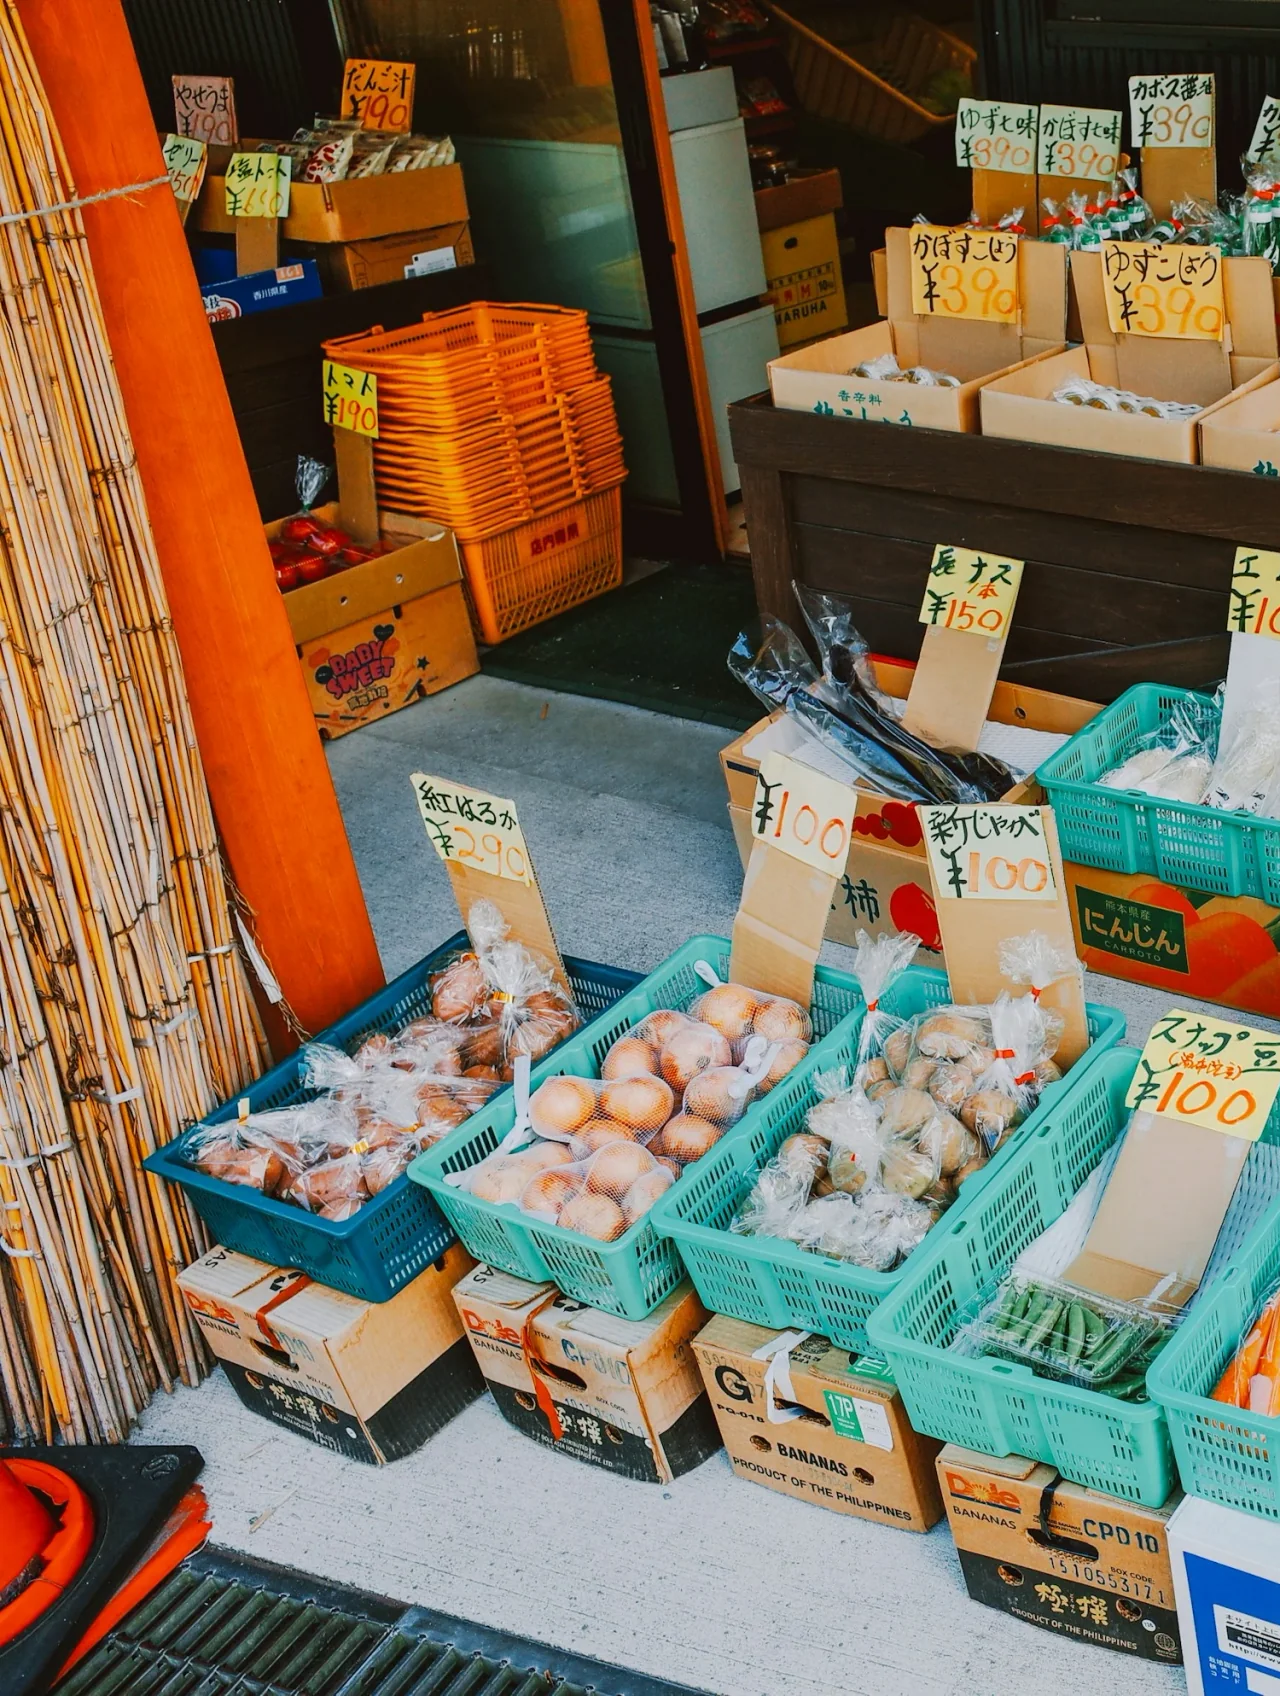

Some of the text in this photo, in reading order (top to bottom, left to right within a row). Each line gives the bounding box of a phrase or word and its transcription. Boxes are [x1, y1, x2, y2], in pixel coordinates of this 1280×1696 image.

[346, 63, 411, 99] だんご汁
[178, 110, 232, 145] ¥190
[349, 94, 408, 128] ¥190
[960, 107, 1037, 138] ゆず七味
[1138, 104, 1211, 143] ¥390
[960, 135, 1030, 168] ¥390
[1045, 139, 1117, 176] ¥390
[922, 262, 1018, 315] ¥390
[1114, 281, 1222, 334] ¥390
[327, 363, 373, 397] トマト
[837, 388, 882, 406] 香辛料
[324, 391, 377, 432] ¥190
[930, 546, 1013, 586] 長ナス
[927, 588, 1003, 632] ¥150
[328, 639, 384, 676] BABY
[326, 656, 395, 700] SWEET
[418, 780, 517, 831] 紅はるか
[755, 772, 847, 859] ¥100
[928, 806, 1041, 845] 新じゃが
[425, 816, 526, 877] ¥290
[940, 846, 1048, 899] ¥100
[1084, 907, 1181, 956] にんじん
[1104, 939, 1162, 963] CARROTO
[1133, 1058, 1257, 1126] ¥100
[199, 1317, 242, 1340] BANANAS
[462, 1308, 522, 1344] Dole
[473, 1337, 523, 1362] BANANAS
[776, 1441, 849, 1478] BANANAS
[732, 1455, 913, 1522] PRODUCT OF THE PHILIPPINES
[945, 1471, 1021, 1509] Dole
[953, 1505, 1017, 1531] BANANAS
[1111, 1566, 1127, 1577] BOX
[1011, 1606, 1138, 1651] PRODUCT OF THE PHILIPPINES
